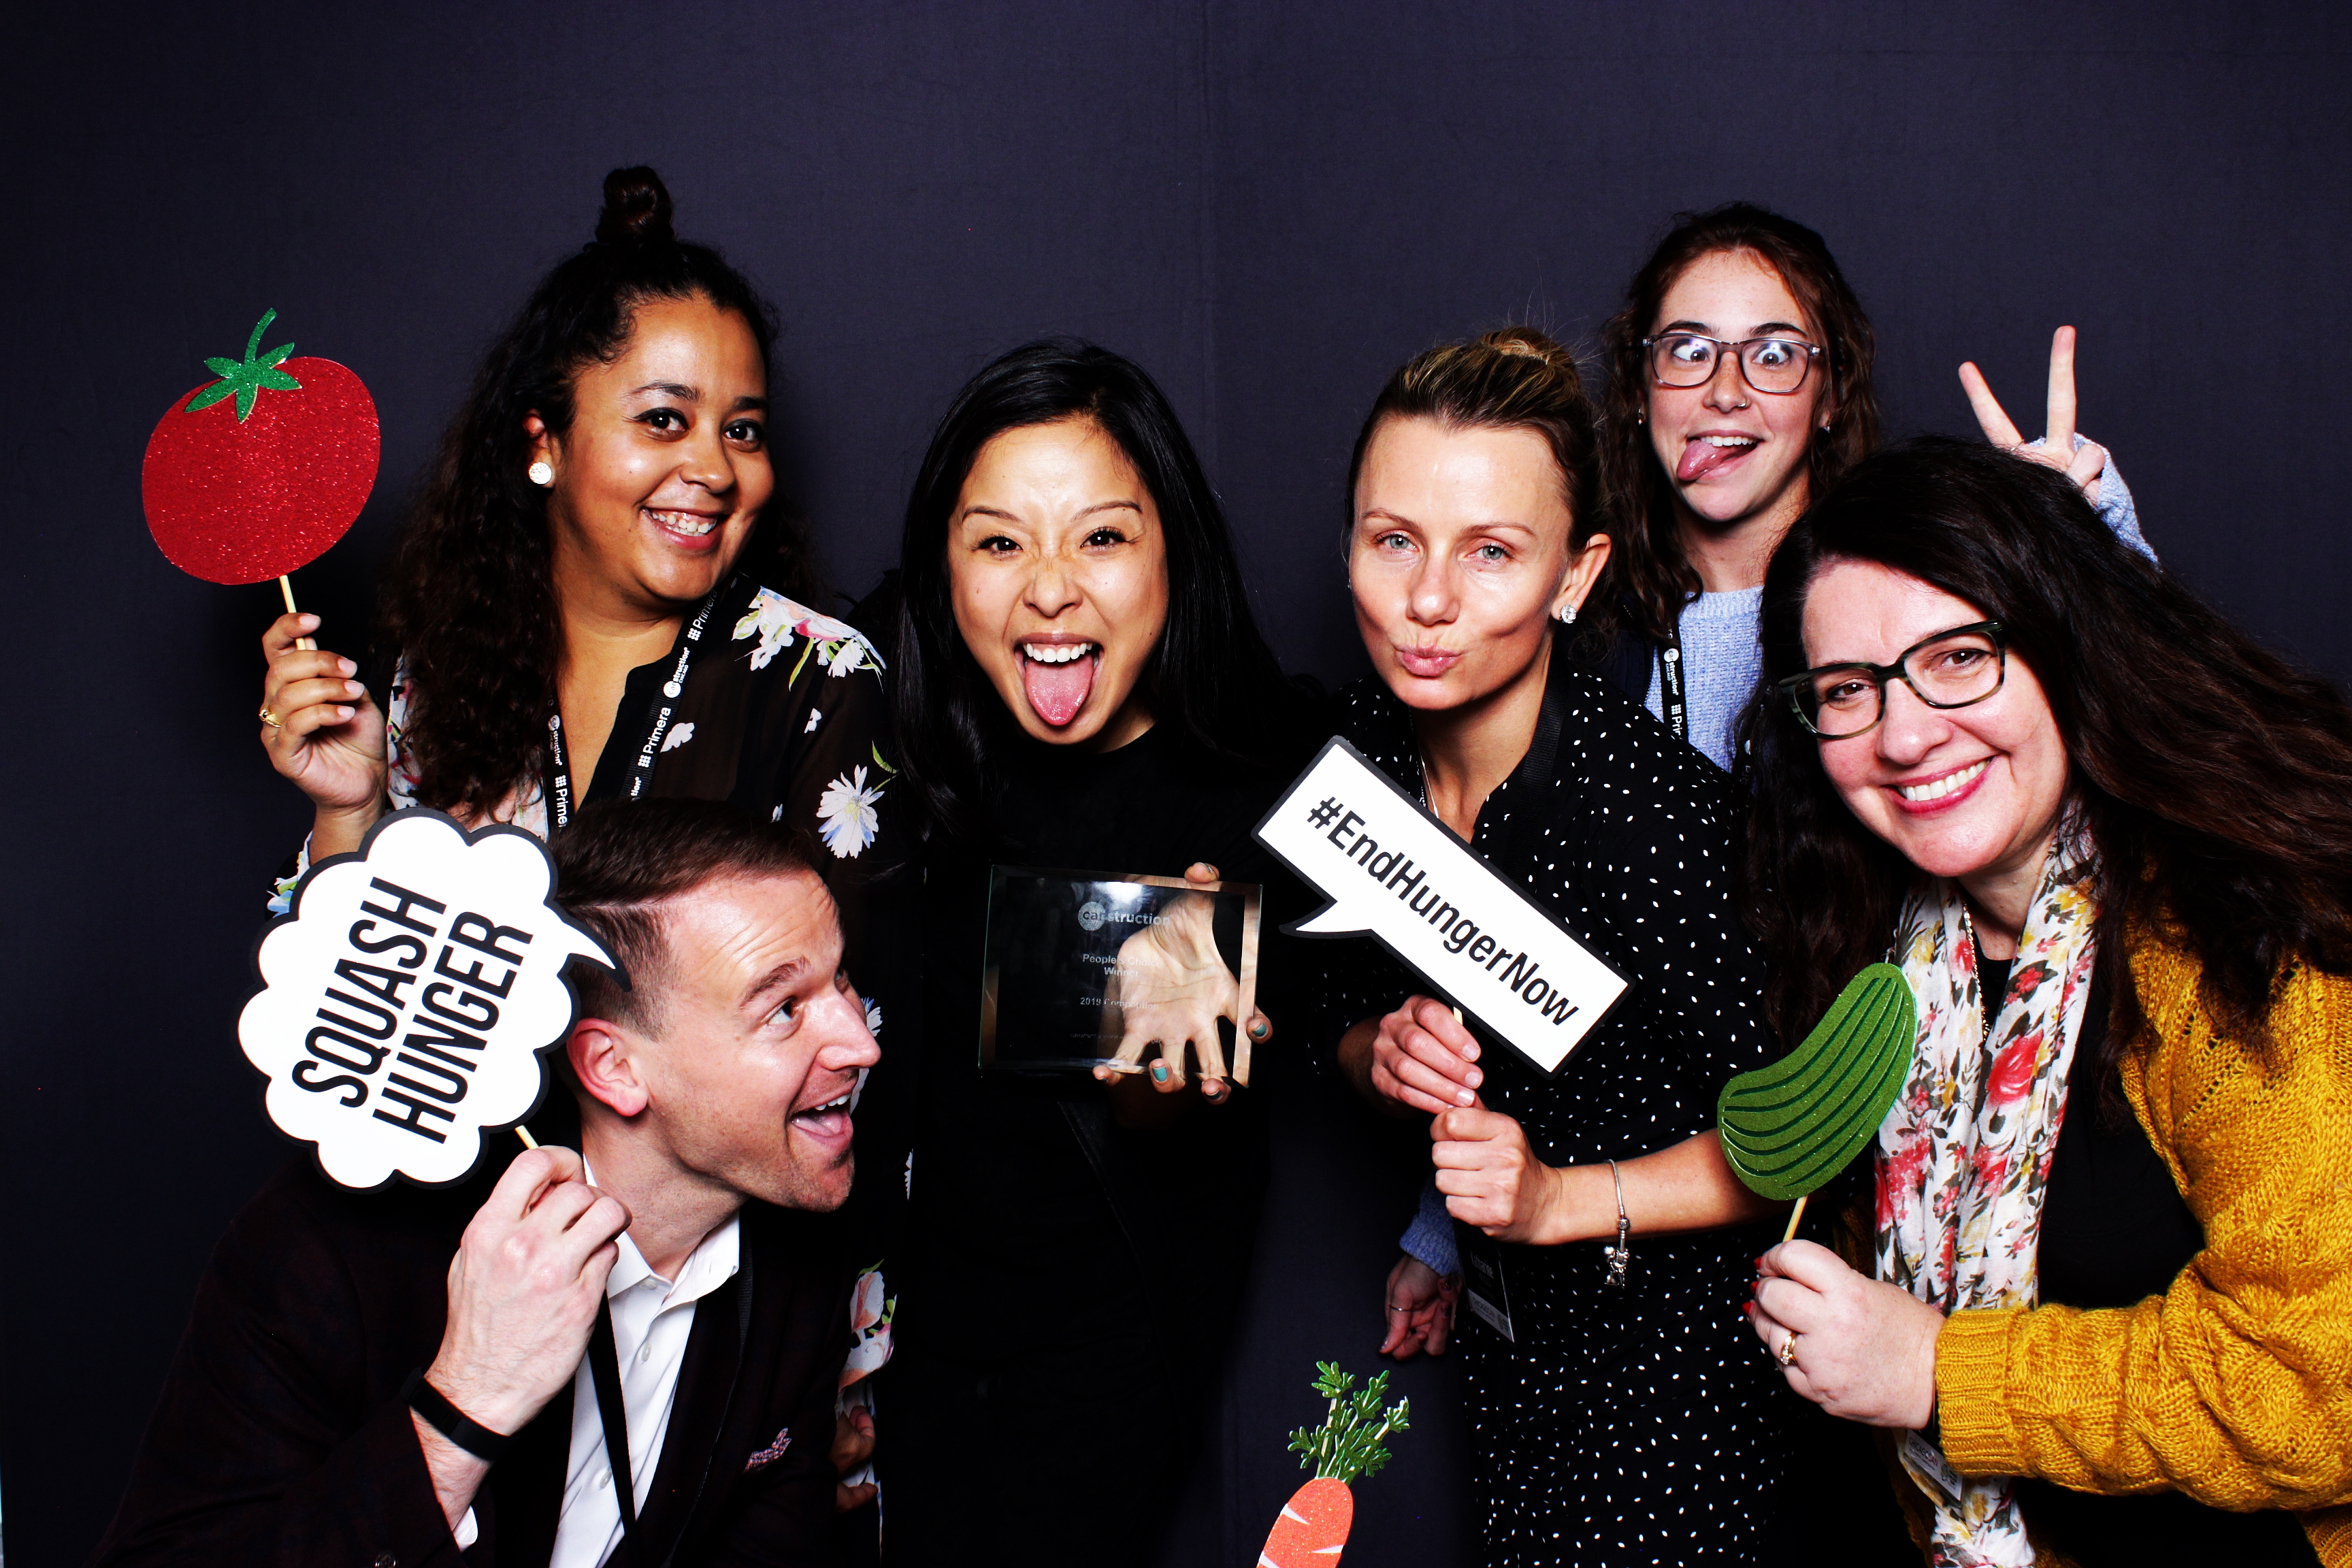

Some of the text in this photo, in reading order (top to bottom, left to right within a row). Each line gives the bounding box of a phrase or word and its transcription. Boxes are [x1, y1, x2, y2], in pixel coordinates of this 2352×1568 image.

[693, 589, 717, 630] Primera
[643, 706, 671, 753] Primera
[291, 876, 447, 1108] SQUASH
[1306, 796, 1579, 1026] #EndHungerNow
[372, 911, 534, 1144] HUNGER
